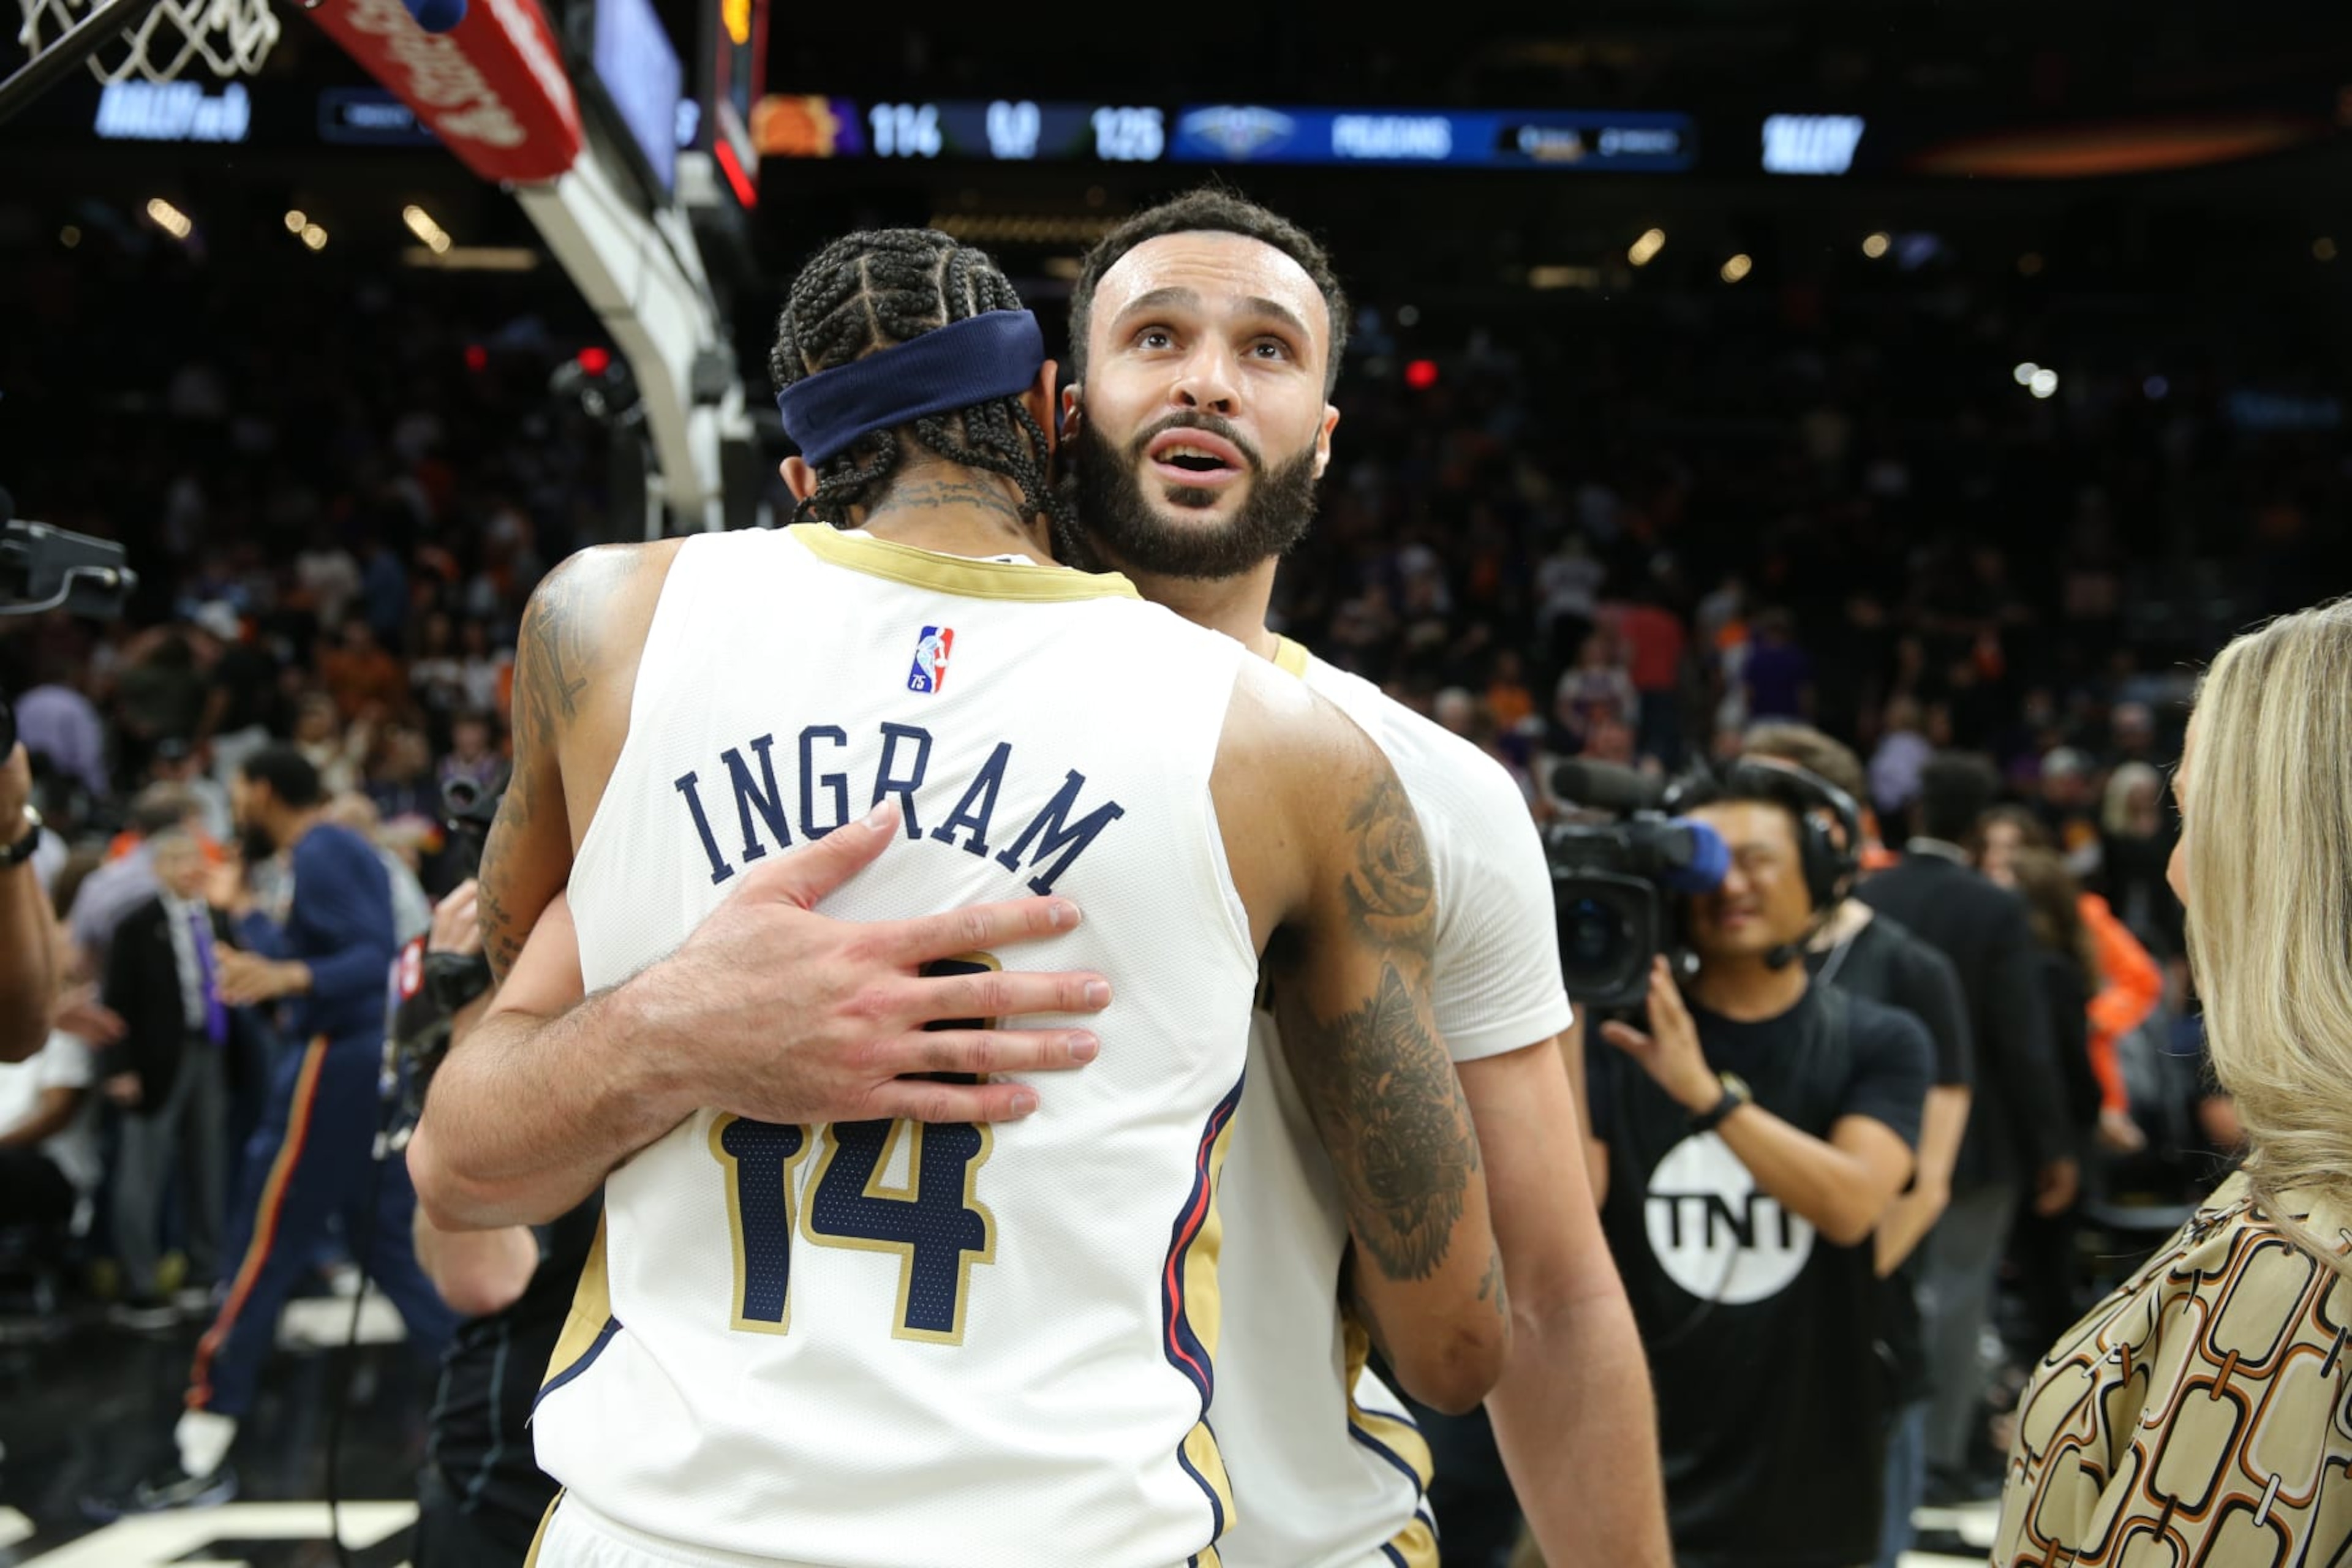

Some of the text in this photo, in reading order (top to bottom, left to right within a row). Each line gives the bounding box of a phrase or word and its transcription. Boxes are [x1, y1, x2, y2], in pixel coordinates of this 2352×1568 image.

[1091, 105, 1165, 162] 125
[910, 674, 926, 690] 75
[674, 722, 1125, 895] INGRAM
[708, 951, 1002, 1346] 14
[1645, 1191, 1792, 1249] TNT
